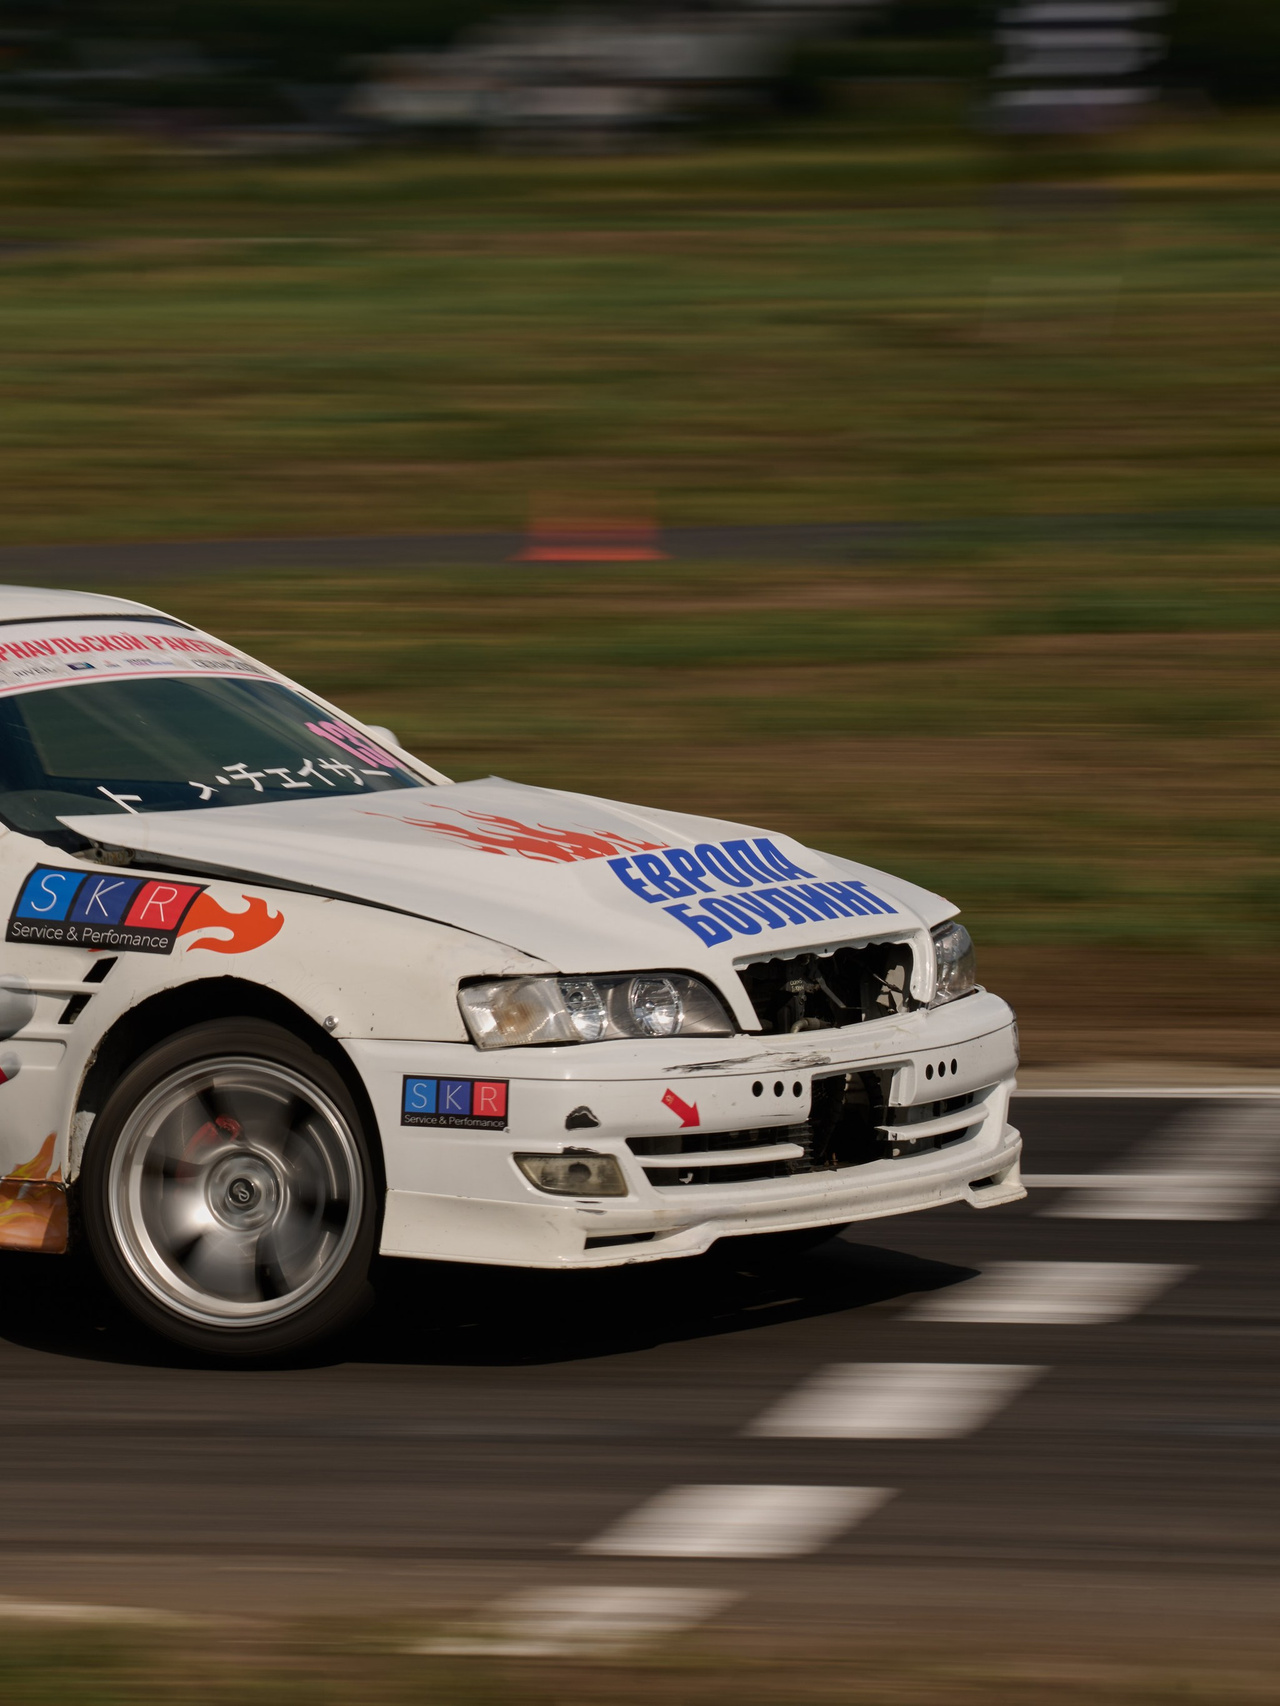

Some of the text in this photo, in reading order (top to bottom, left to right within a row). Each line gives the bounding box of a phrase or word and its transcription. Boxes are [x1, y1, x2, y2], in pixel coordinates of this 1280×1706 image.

[606, 837, 818, 905] ЕВРОПА
[30, 873, 178, 923] SKR
[661, 880, 899, 948] БОУЛИНГ
[11, 921, 169, 949] Service & Perfomance
[411, 1082, 498, 1112] SKR
[404, 1114, 505, 1128] Service & Perfomance
